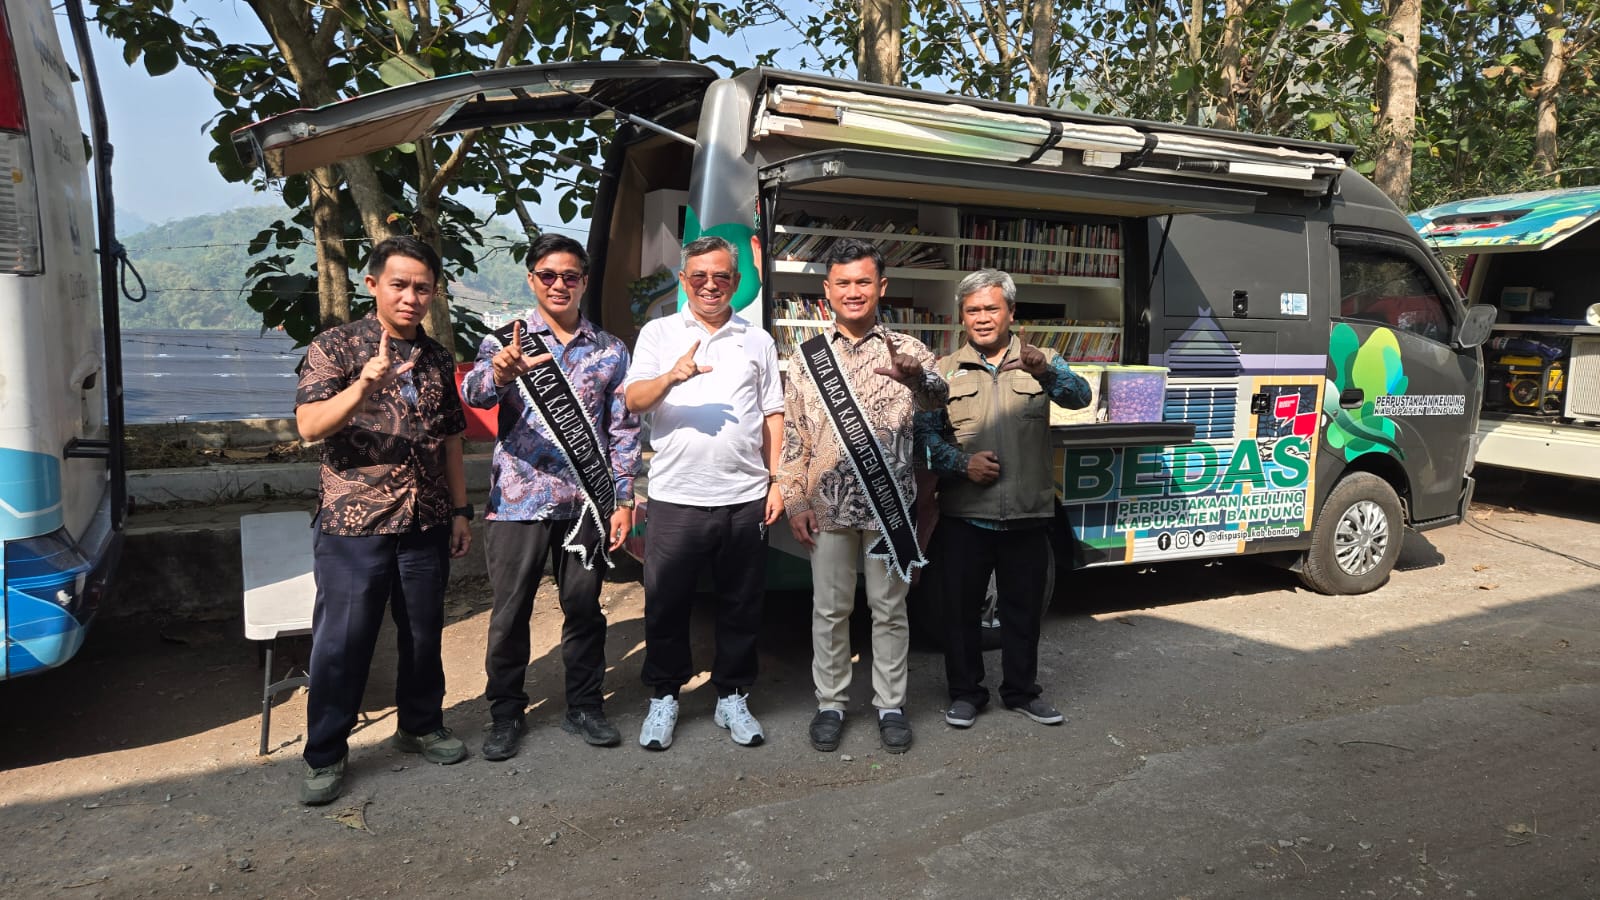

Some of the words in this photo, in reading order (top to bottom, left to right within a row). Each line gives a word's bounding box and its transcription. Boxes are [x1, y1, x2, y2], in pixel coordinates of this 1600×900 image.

[526, 362, 560, 398] ACA
[545, 393, 595, 465] KABUPATEN
[1374, 406, 1425, 415] KABUPATEN
[1426, 406, 1465, 415] BANDUNG
[1375, 395, 1433, 407] PERPUSTAKAAN
[1433, 395, 1465, 406] KELILING
[810, 348, 831, 379] DUTA
[823, 375, 848, 408] BACA
[838, 406, 880, 475] KABUPATEN
[872, 473, 904, 532] BANDUNG
[1064, 436, 1310, 500] BEDAS
[1118, 496, 1239, 515] PERPUSTAKAAN
[1240, 492, 1303, 506] KELILING
[1117, 512, 1220, 530] KABUPATEN
[1227, 505, 1303, 522] BANDUNG
